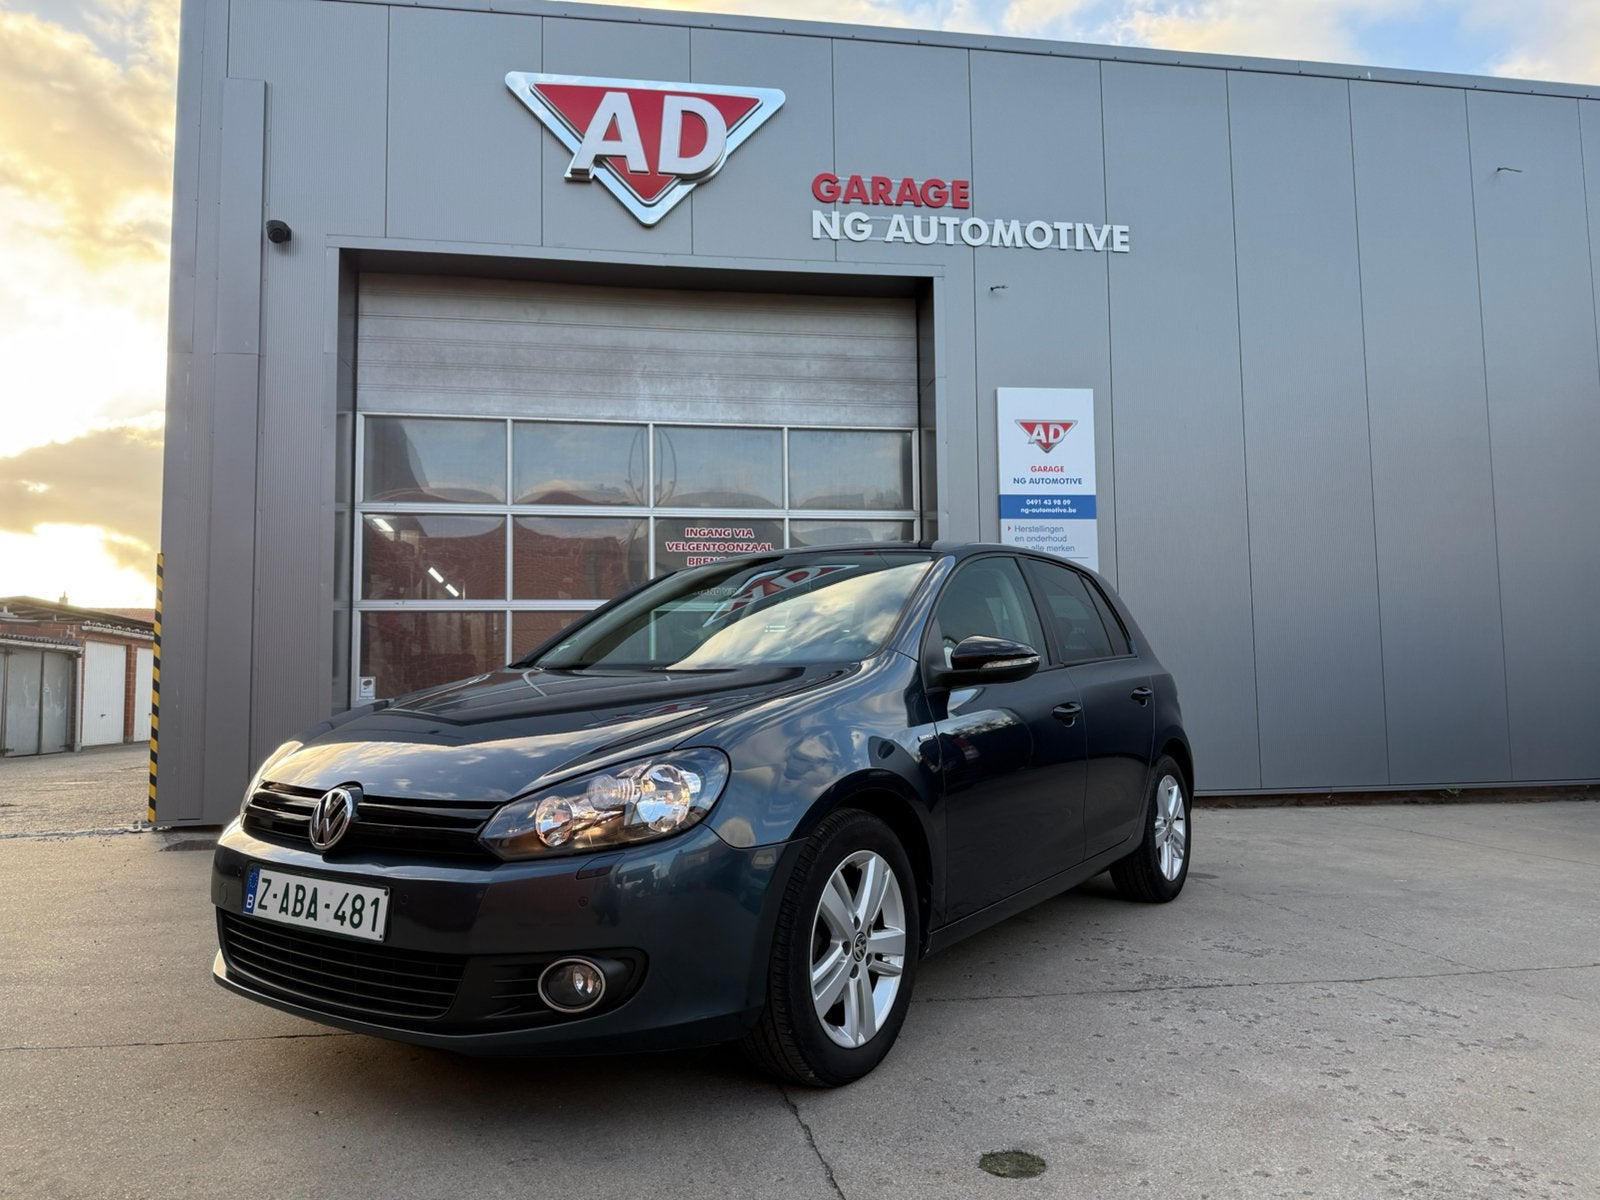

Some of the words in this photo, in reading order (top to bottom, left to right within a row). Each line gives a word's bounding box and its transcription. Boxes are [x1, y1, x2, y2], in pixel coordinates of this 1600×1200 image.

[566, 91, 728, 181] AD
[812, 172, 970, 209] GARAGE
[812, 210, 873, 242] NG
[884, 213, 1130, 253] AUTOMOTIVE
[1028, 423, 1065, 444] AD
[1030, 465, 1064, 473] GARAGE
[1013, 477, 1027, 485] NG
[1029, 477, 1083, 485] AUTOMOTIVE
[685, 528, 731, 538] INGANG
[734, 528, 755, 538] VIA
[1014, 525, 1064, 534] Herstellingen
[666, 541, 774, 553] VELGENTOONZAAL
[246, 894, 255, 909] B
[257, 878, 381, 932] Z-ABA-481
